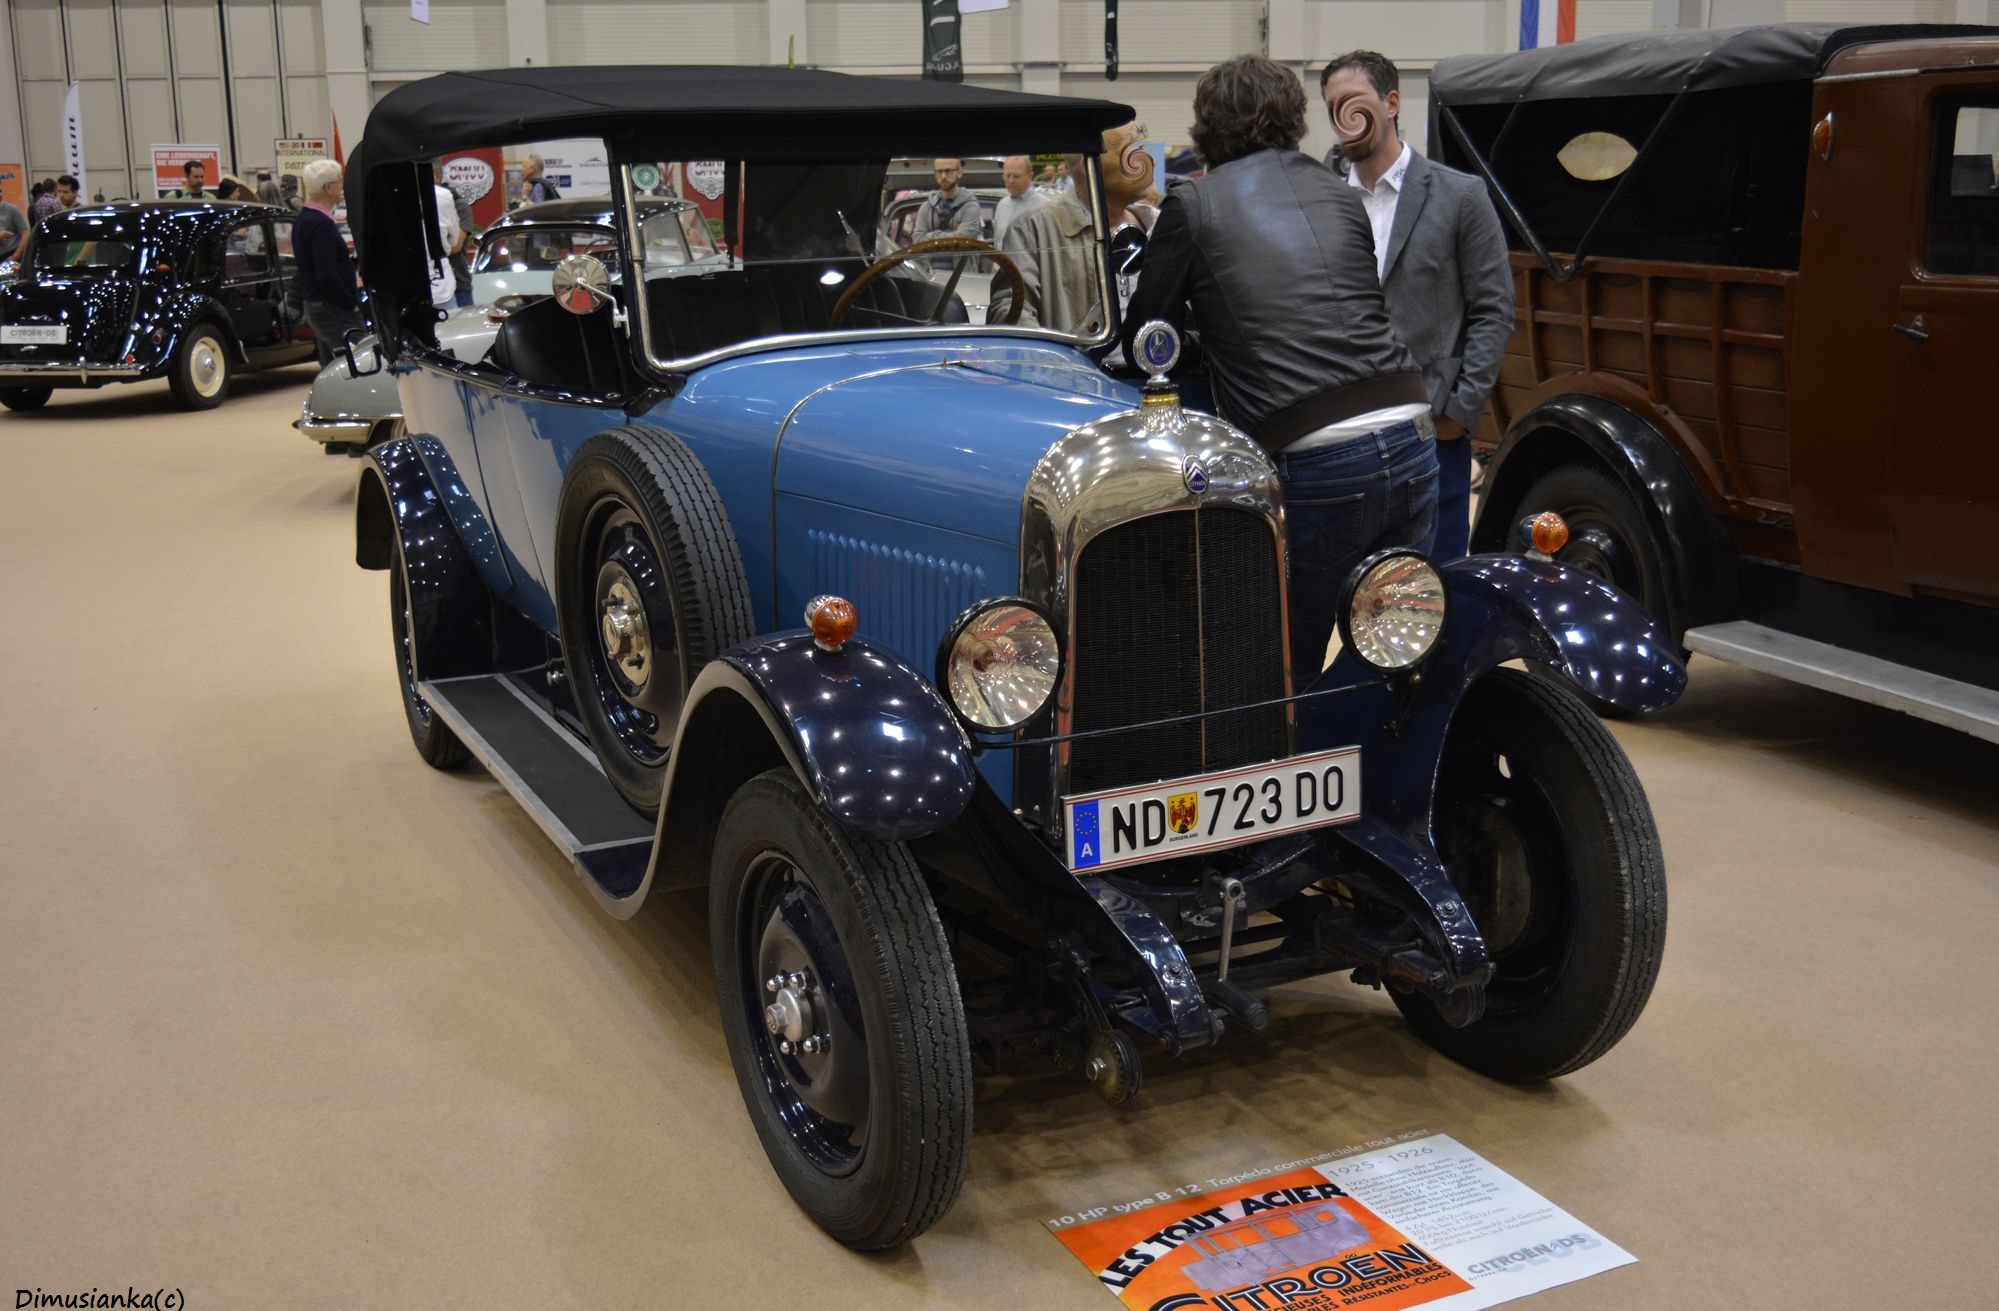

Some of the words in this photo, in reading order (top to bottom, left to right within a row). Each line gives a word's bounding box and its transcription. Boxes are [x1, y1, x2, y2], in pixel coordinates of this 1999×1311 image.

[1112, 798, 1166, 853] ND
[1204, 776, 1282, 836] 723
[1295, 764, 1344, 818] DO
[1080, 842, 1093, 858] A
[1169, 832, 1199, 842] BURGENLAND
[1048, 1215, 1075, 1227] 10
[1077, 1206, 1108, 1221] HP
[1112, 1196, 1155, 1213] type
[1154, 1191, 1172, 1201] B
[1175, 1183, 1203, 1196] 12
[1206, 1166, 1271, 1188] Torpédo
[1274, 1145, 1364, 1172] commerciale
[1365, 1135, 1393, 1148] tout
[1397, 1128, 1429, 1140] acier
[1328, 1160, 1375, 1178] 1925
[1387, 1145, 1434, 1162] 1926
[1098, 1247, 1155, 1288] LES
[1143, 1206, 1232, 1250] TOUT
[1239, 1182, 1349, 1217] ACIER
[1467, 1243, 1554, 1274] CITROËN
[1557, 1233, 1586, 1248] DS
[1337, 1263, 1443, 1297] INDÉFORMABLES
[1341, 1283, 1410, 1306] RÉSISTANTES
